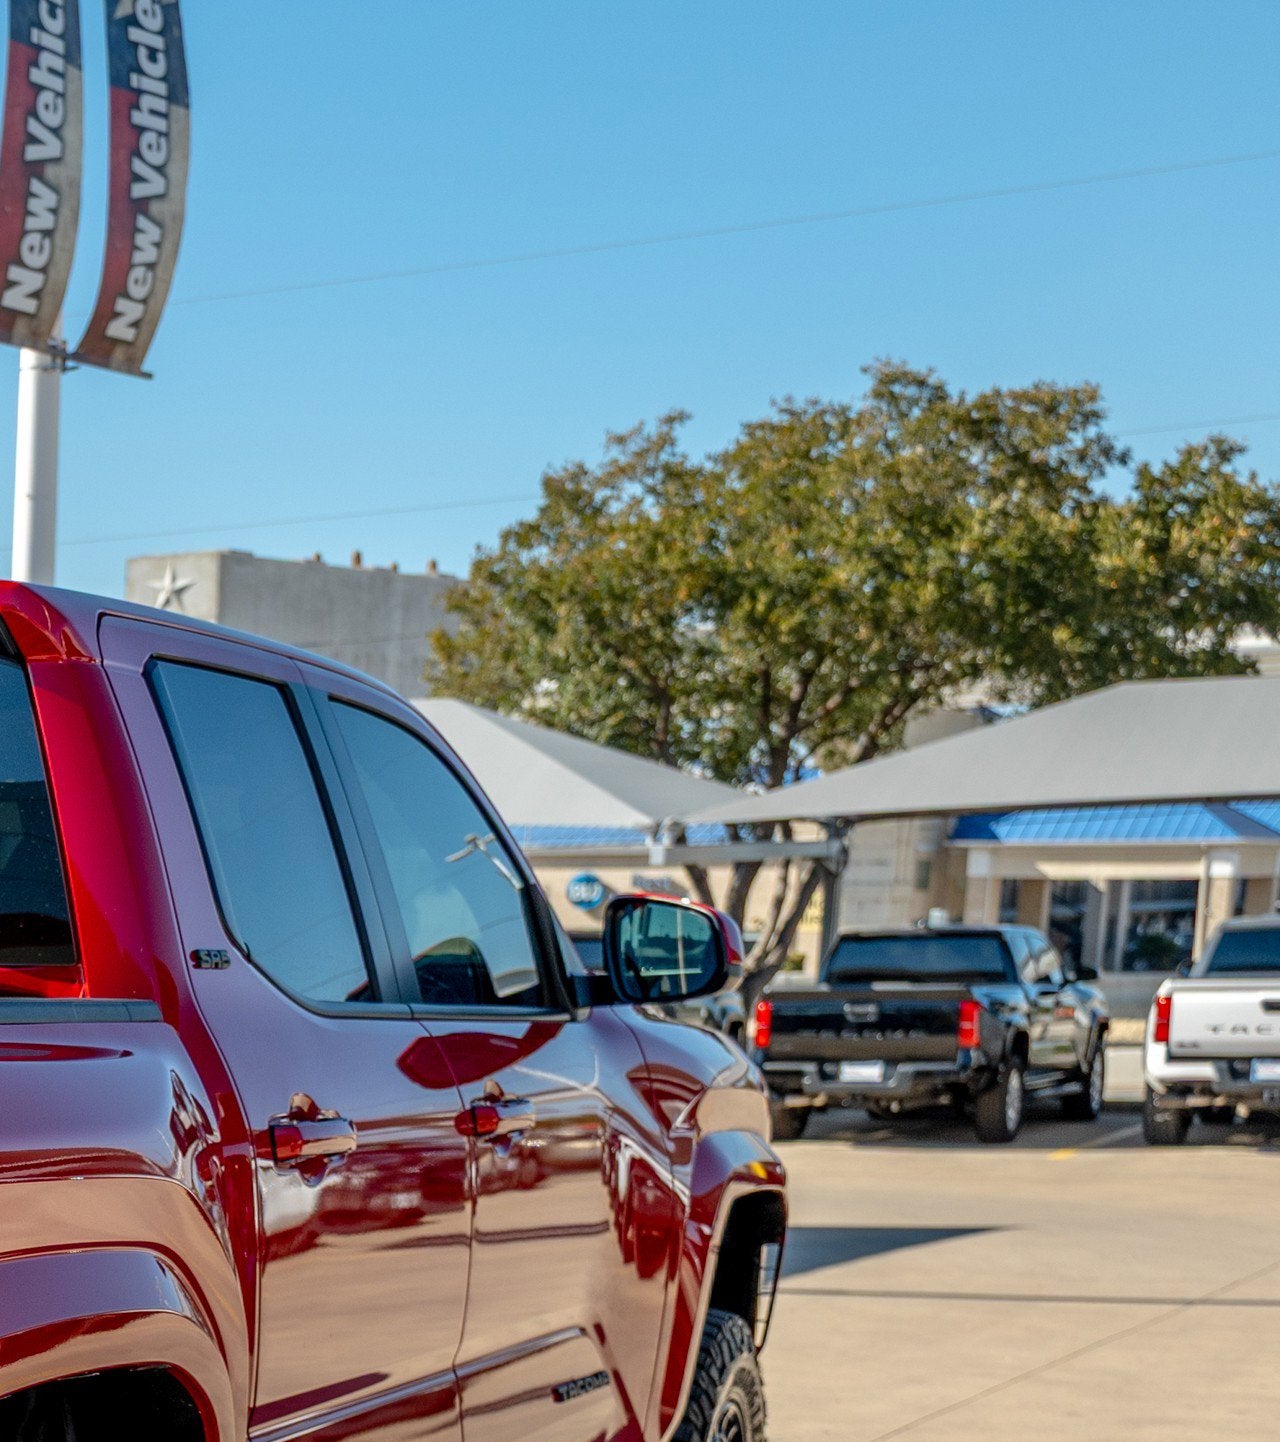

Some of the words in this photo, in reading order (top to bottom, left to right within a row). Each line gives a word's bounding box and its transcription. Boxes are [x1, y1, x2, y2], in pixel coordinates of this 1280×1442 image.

[23, 0, 67, 163] Vehic
[0, 177, 61, 316] New
[105, 213, 162, 343] New
